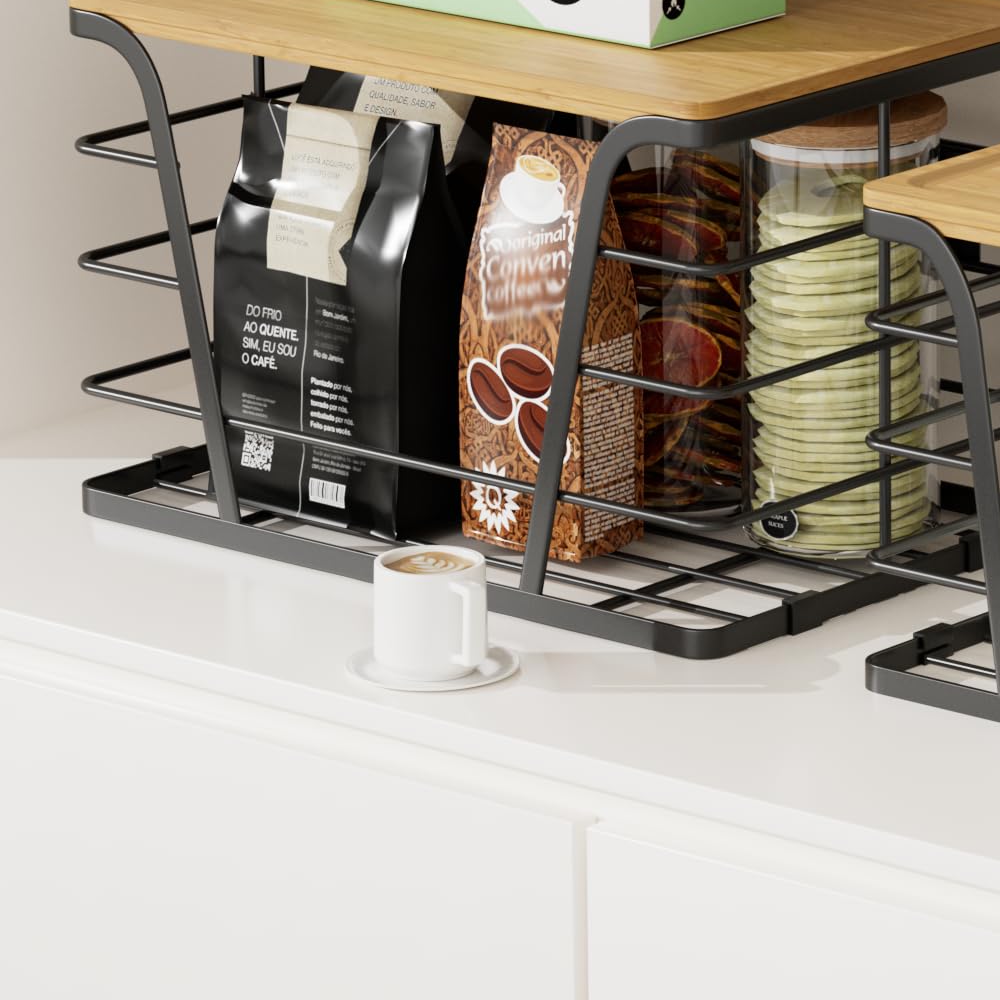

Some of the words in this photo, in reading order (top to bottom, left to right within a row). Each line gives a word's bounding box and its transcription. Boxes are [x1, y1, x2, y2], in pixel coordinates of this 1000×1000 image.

[410, 98, 436, 110] SABOR
[245, 303, 261, 318] DO
[262, 306, 282, 321] FRIO
[243, 321, 258, 334] AO
[259, 322, 299, 342] QUENTE.
[242, 336, 260, 353] SIM,
[262, 340, 276, 354] EU
[276, 342, 298, 358] SOU
[241, 352, 250, 365] O
[250, 353, 278, 370] CAFÉ.
